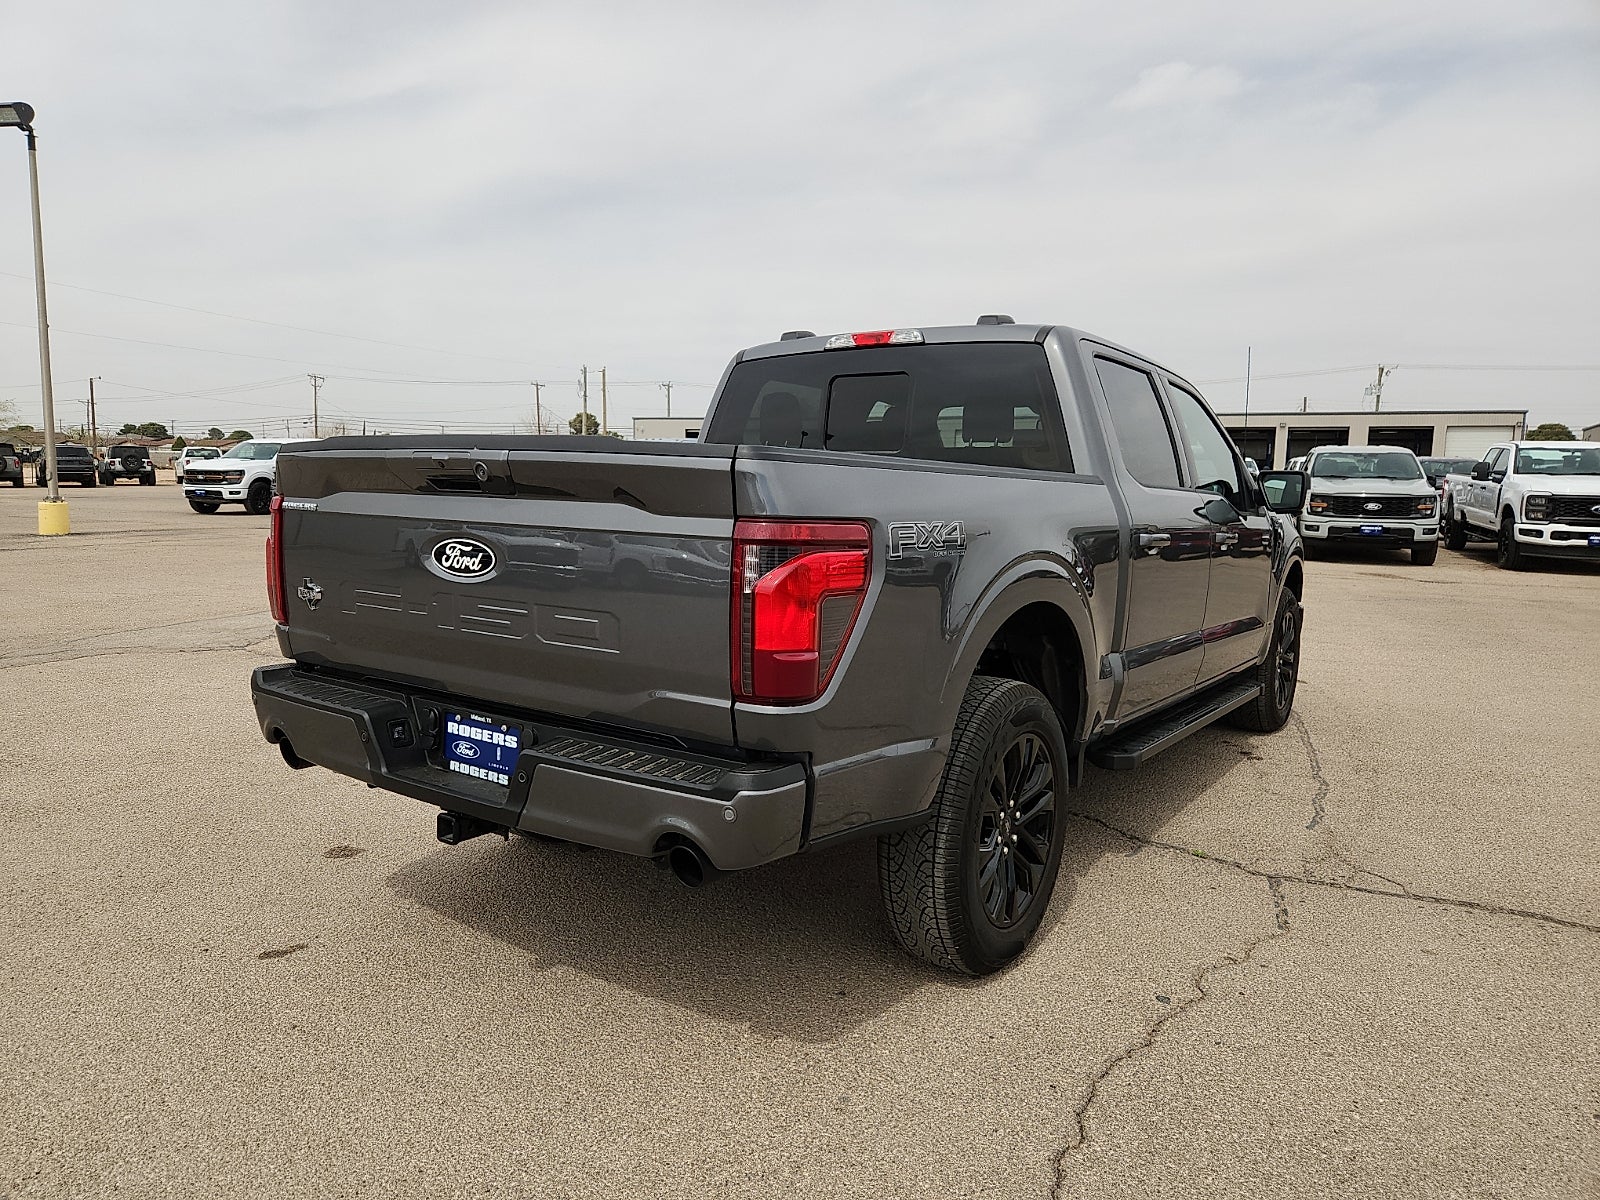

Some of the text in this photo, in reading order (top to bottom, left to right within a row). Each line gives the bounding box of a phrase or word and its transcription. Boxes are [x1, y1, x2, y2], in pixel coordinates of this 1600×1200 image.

[888, 521, 966, 560] FX4
[441, 543, 483, 571] Ford
[338, 579, 621, 655] F-150
[447, 721, 518, 748] ROGERS
[456, 742, 475, 756] Ford
[449, 760, 509, 785] ROGERS
